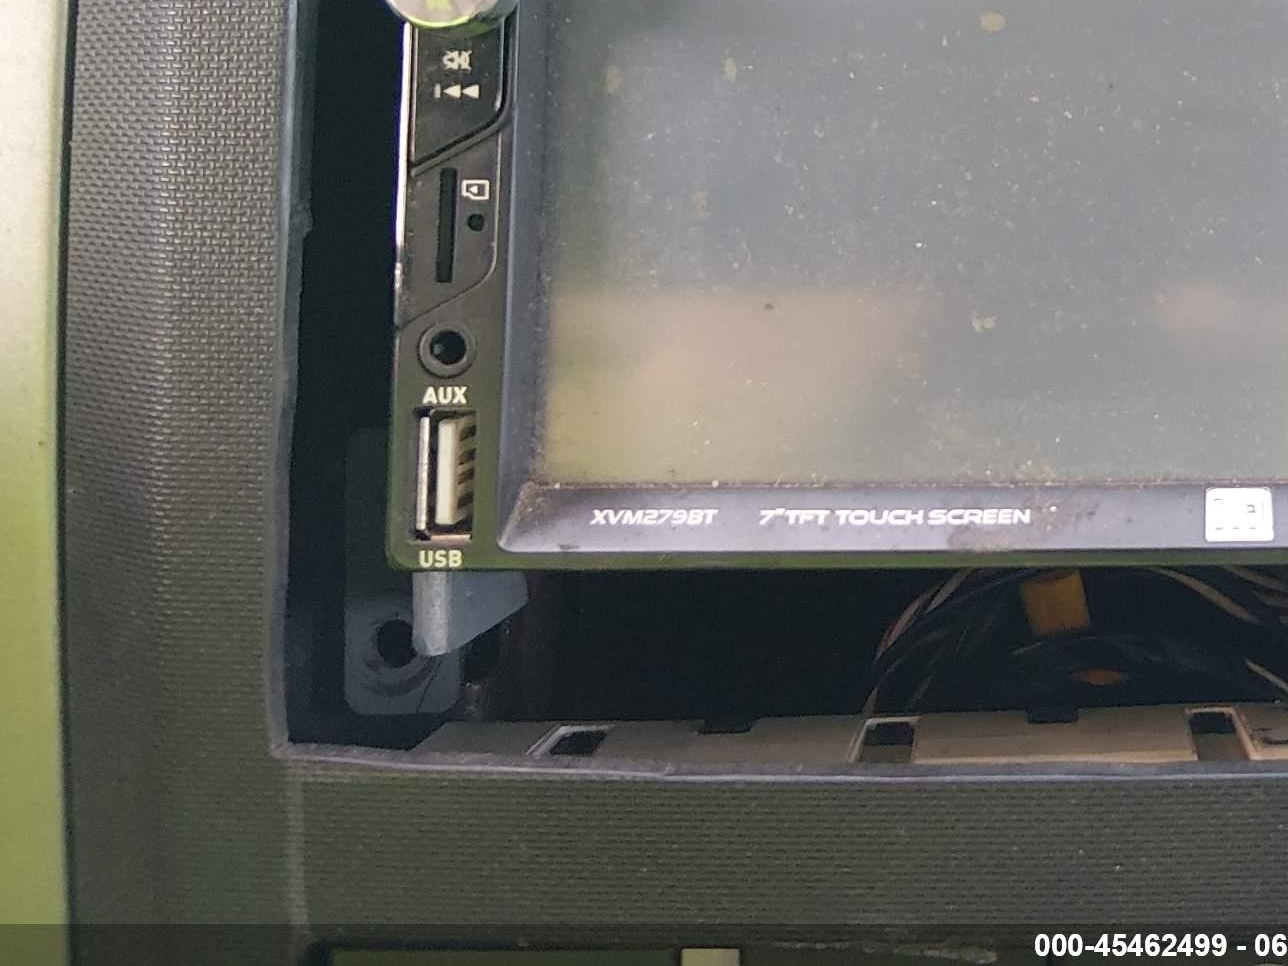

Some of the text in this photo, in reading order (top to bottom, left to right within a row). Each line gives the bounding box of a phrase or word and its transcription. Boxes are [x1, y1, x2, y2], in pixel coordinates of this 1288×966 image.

[422, 386, 467, 404] AUX
[590, 509, 718, 526] XVM279BT
[834, 509, 924, 525] TOUCH
[927, 509, 1031, 524] SCREEN
[419, 550, 463, 568] USB
